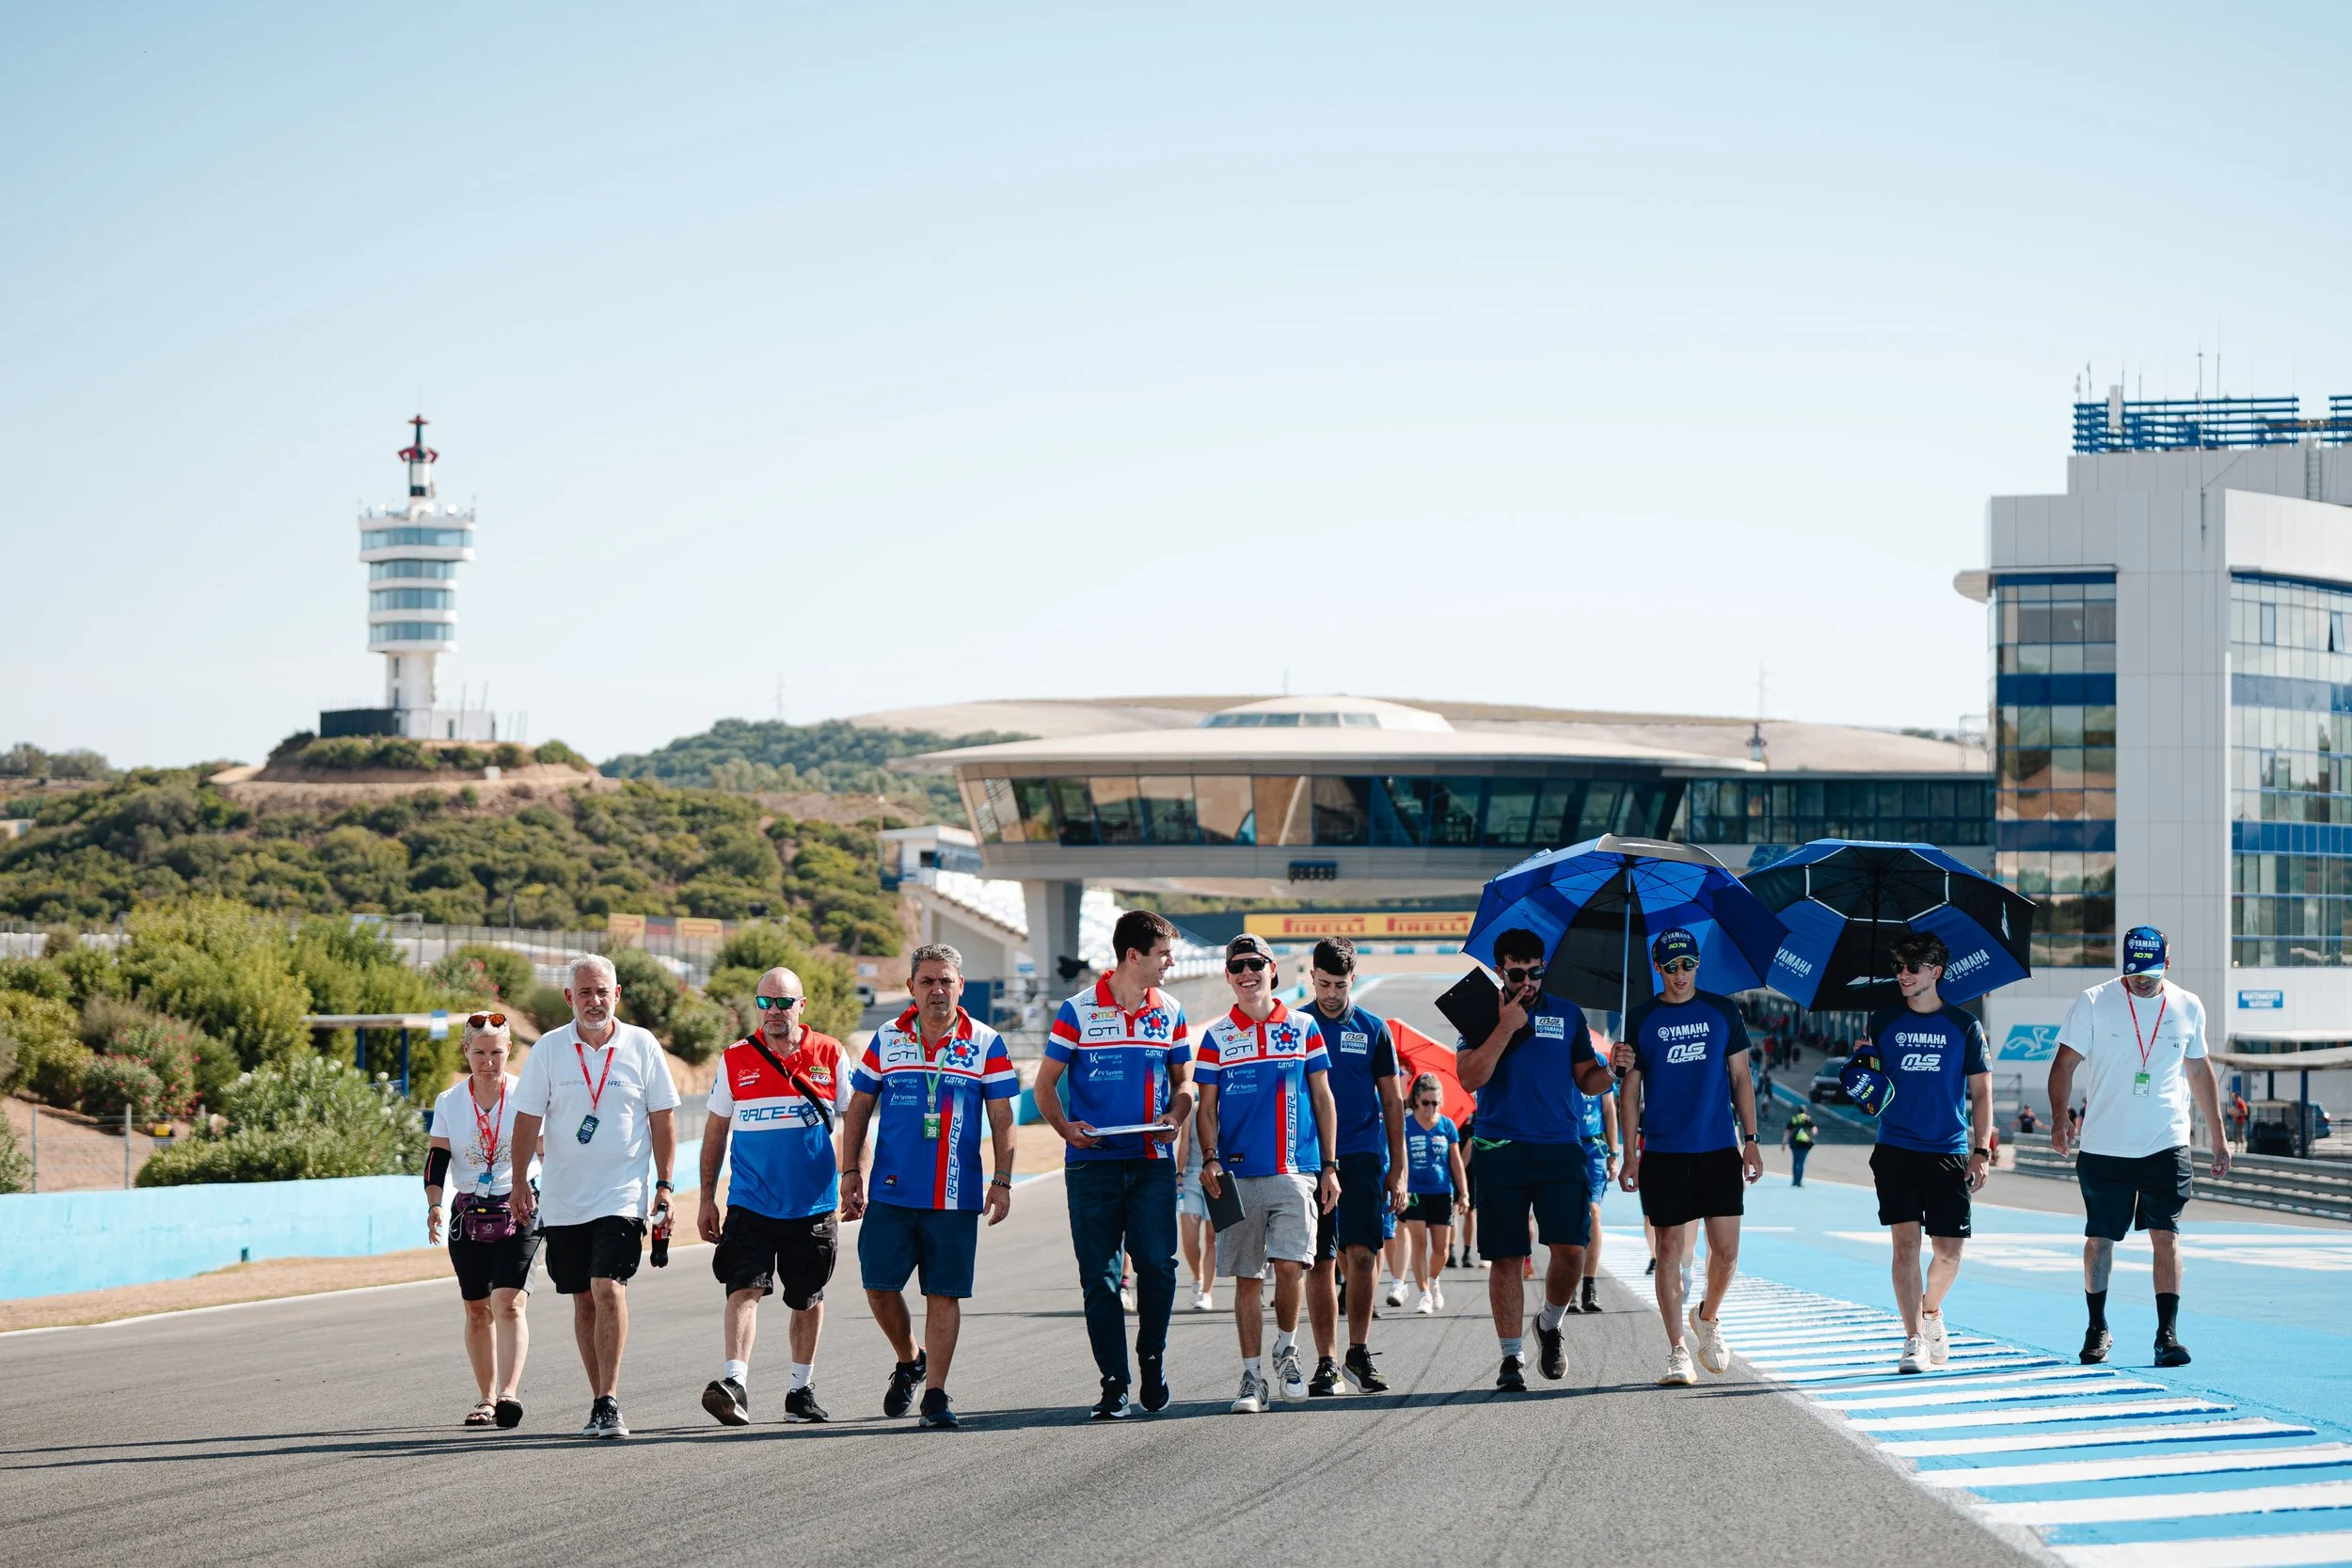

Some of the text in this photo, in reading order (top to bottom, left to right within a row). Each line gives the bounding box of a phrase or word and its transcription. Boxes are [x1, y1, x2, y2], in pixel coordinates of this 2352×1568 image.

[1283, 917, 1364, 933] PIRELLI
[1387, 916, 1469, 932] PIRELLI
[1667, 931, 1692, 940] YAMAHA
[2135, 940, 2160, 948] YAMAHA
[1775, 946, 1813, 975] YAMAHA
[1951, 948, 1991, 975] YAMAHA
[1949, 960, 1990, 983] RACING
[1669, 1022, 1710, 1037] YAMAHA
[1907, 1033, 1947, 1045] YAMAHA
[1851, 1073, 1870, 1097] YAMAHA
[1287, 1093, 1296, 1166] RACESTAR
